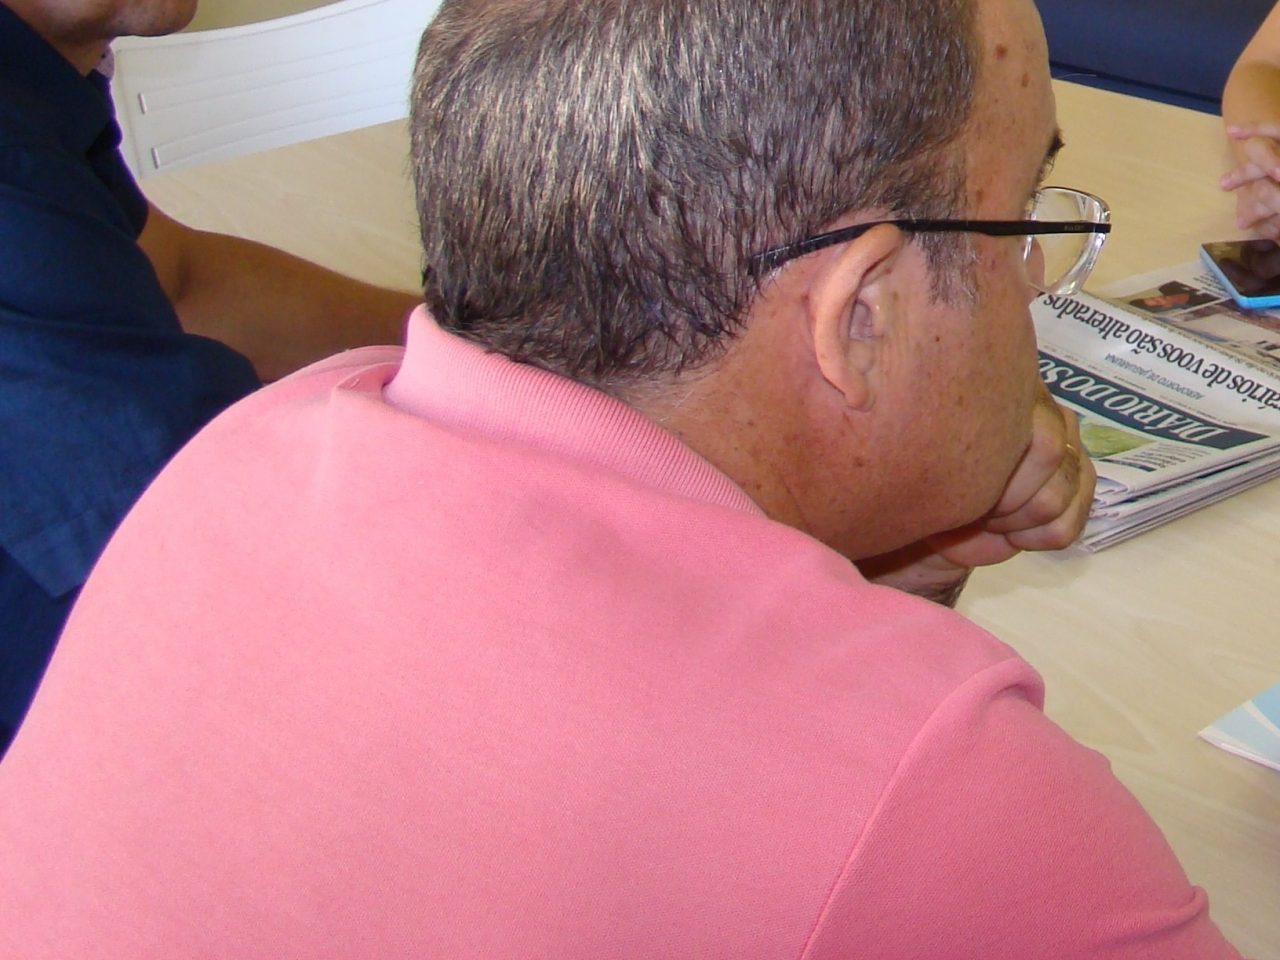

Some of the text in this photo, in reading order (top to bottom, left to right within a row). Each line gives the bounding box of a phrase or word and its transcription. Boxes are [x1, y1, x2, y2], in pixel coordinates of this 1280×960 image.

[1043, 294, 1130, 340] alterados
[1125, 328, 1163, 354] são
[1157, 340, 1205, 374] voos
[1060, 375, 1121, 402] DO
[1104, 353, 1207, 400] AEROPORTO DE JAGUARUNA
[1201, 363, 1233, 387] de
[1103, 393, 1230, 441] DIÁRIO
